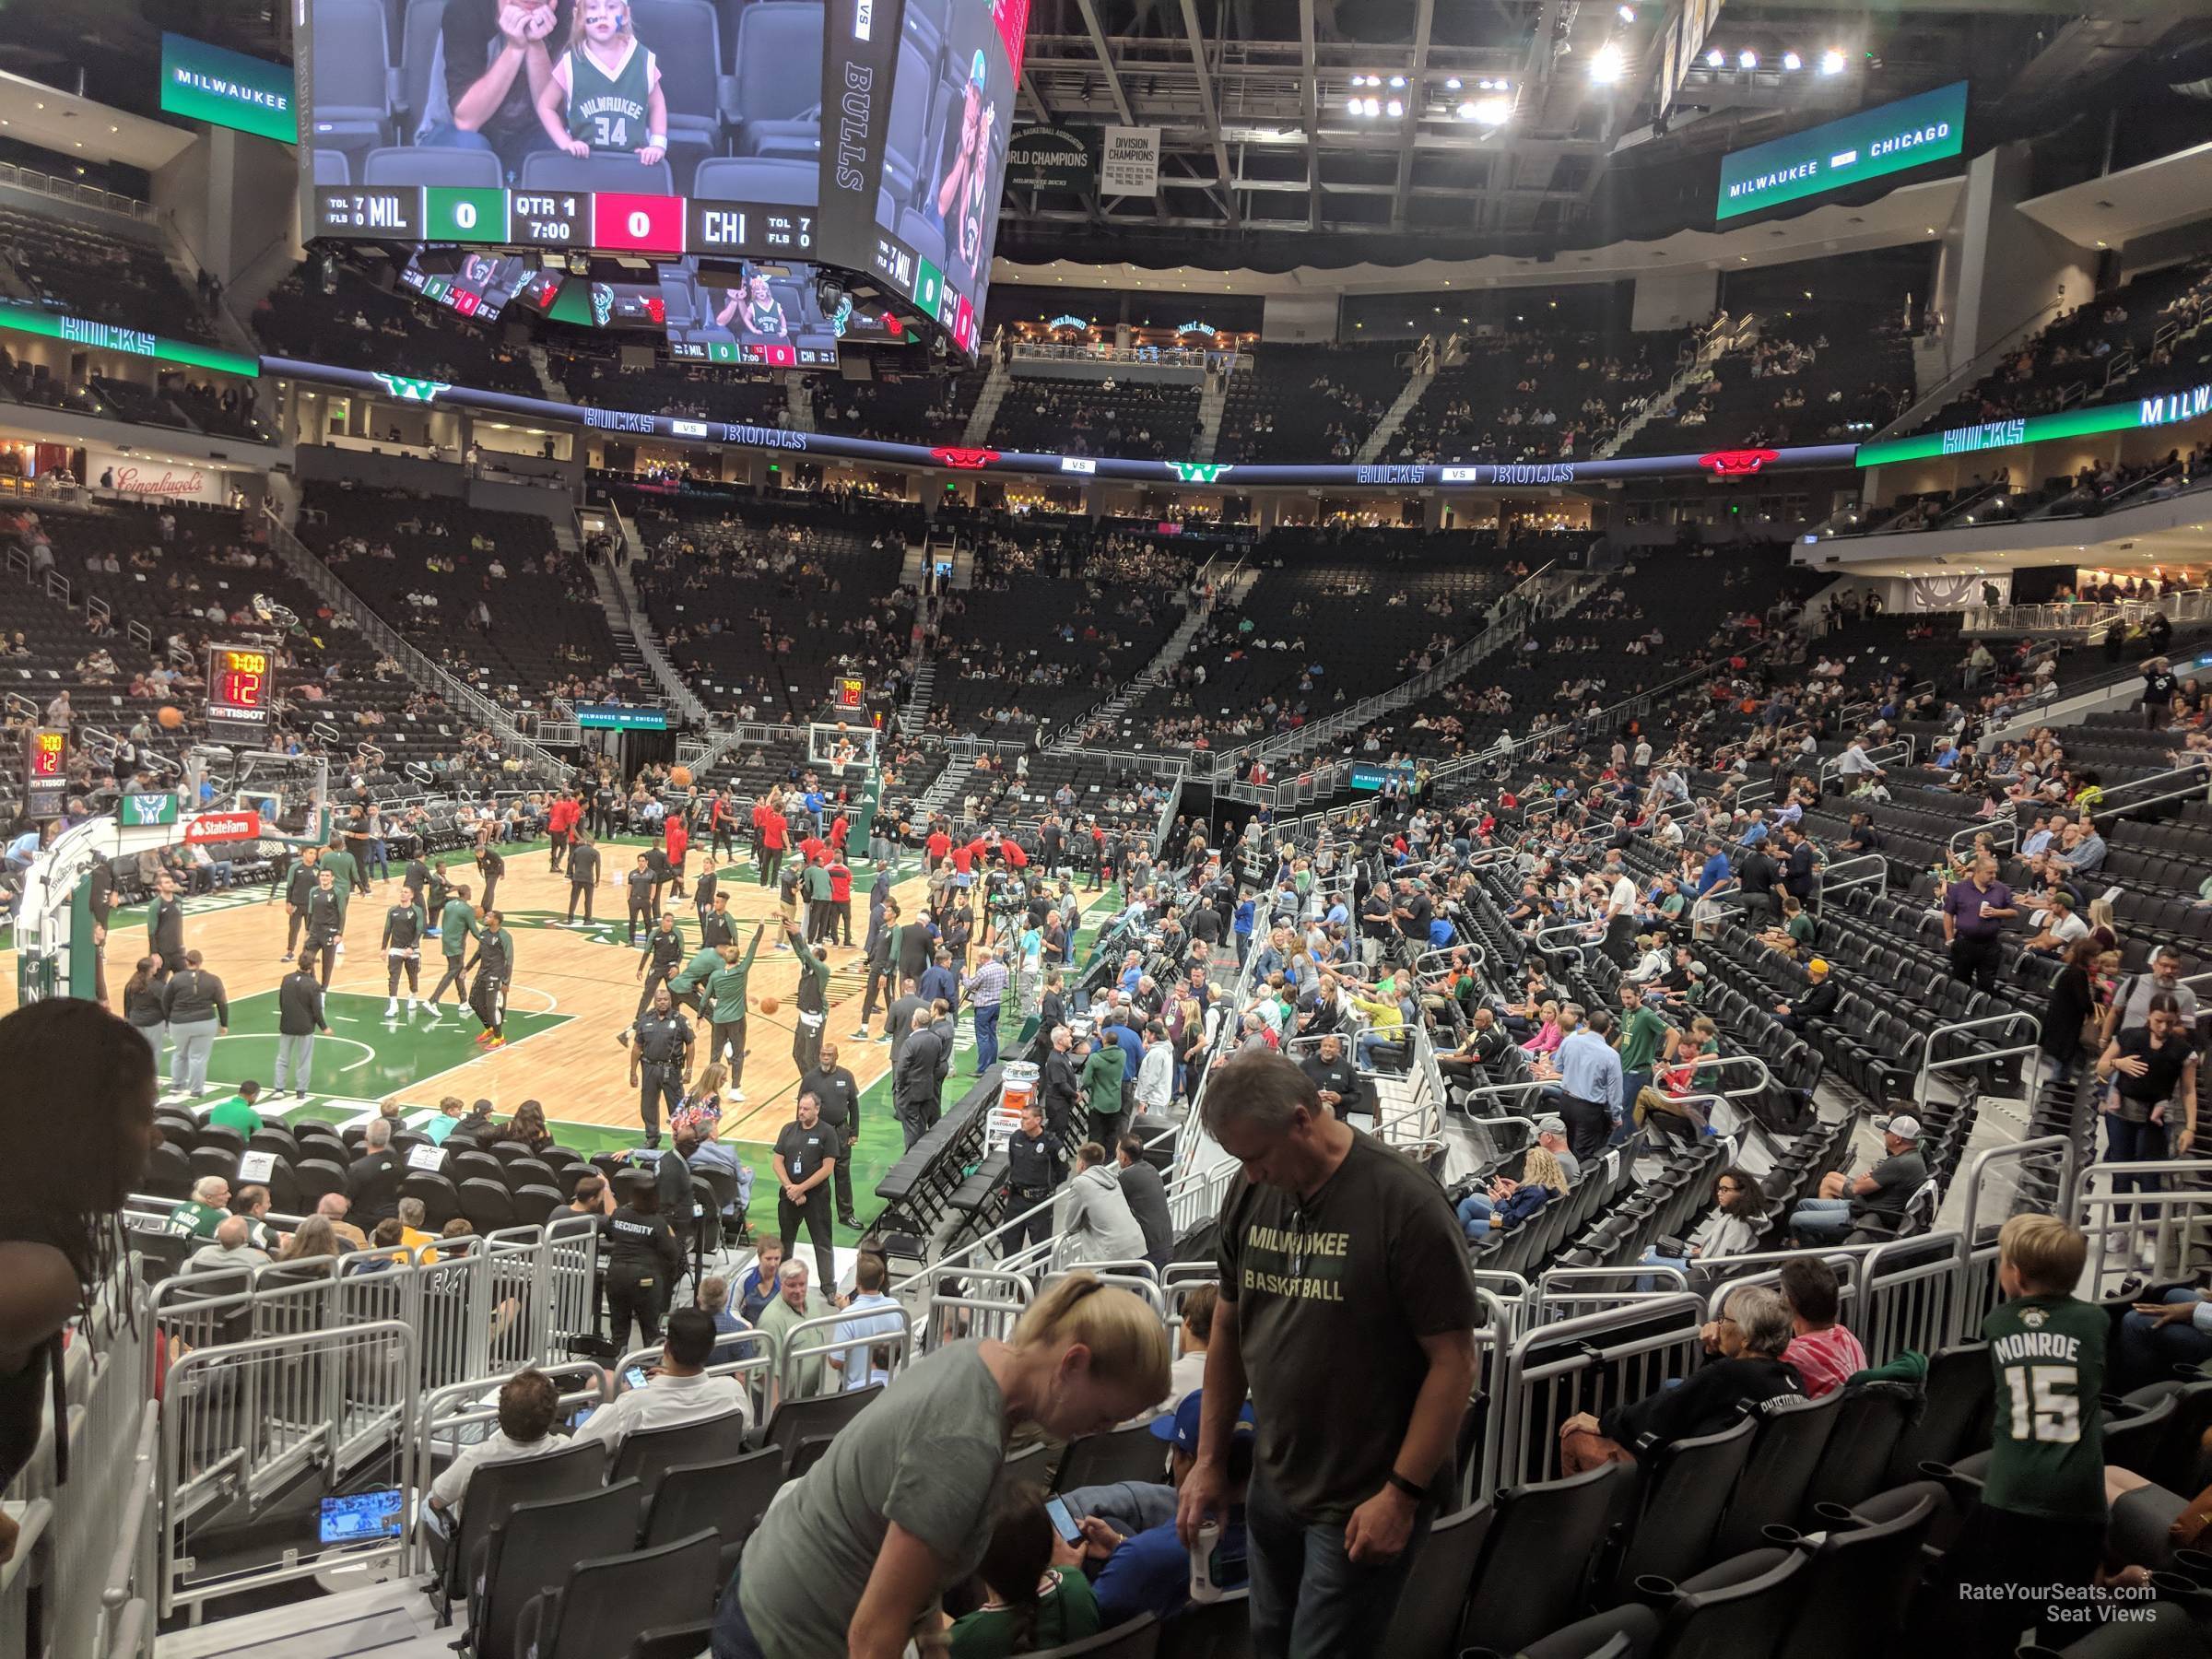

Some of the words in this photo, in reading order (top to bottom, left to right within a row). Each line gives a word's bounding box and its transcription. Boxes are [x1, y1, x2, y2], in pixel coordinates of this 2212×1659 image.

[859, 5, 870, 25] VS
[176, 68, 288, 111] MILWAUKEE
[579, 96, 644, 120] MILWAUKEE
[594, 117, 628, 146] 34
[836, 61, 873, 192] BULLS
[1115, 137, 1148, 149] DIVISION
[1006, 150, 1030, 166] ORLD
[1031, 152, 1088, 168] CHAMPIONS
[1108, 150, 1155, 161] CHAMPIONS
[1729, 161, 1818, 198] MILWAUKEE
[1870, 123, 1949, 158] CHICAGO
[330, 198, 348, 208] TOL
[356, 197, 364, 210] 7
[370, 197, 407, 228] MIL
[456, 203, 477, 229] 0
[516, 197, 555, 216] QTR
[563, 198, 576, 217] 1
[330, 214, 348, 224] FLS
[356, 213, 364, 226] 0
[628, 211, 651, 238] 0
[704, 211, 746, 244] CHI
[769, 218, 791, 229] TOL
[800, 218, 810, 230] 7
[531, 222, 570, 240] 7:00
[768, 234, 790, 244] FLS
[800, 234, 810, 247] 0
[895, 252, 911, 287] MIL
[925, 278, 934, 302] 0
[961, 314, 968, 335] 0
[689, 344, 705, 356] MIL
[720, 346, 729, 358] 0
[742, 353, 759, 362] 7:00
[776, 349, 785, 361] 0
[800, 350, 816, 362] CHI
[682, 424, 697, 433] VS
[723, 423, 806, 451] BULLS
[1072, 462, 1086, 470] VS
[1452, 470, 1466, 478] VS
[1491, 462, 1574, 484] BULLS
[228, 653, 265, 674] 7:00
[232, 673, 259, 704] 12
[843, 680, 862, 691] 7:00
[845, 690, 858, 704] 12
[225, 708, 266, 721] TISSOT
[42, 751, 57, 772] 12
[614, 1219, 654, 1236] SECURITY
[1994, 1332, 2082, 1364] MONROE
[2004, 1365, 2081, 1443] 15
